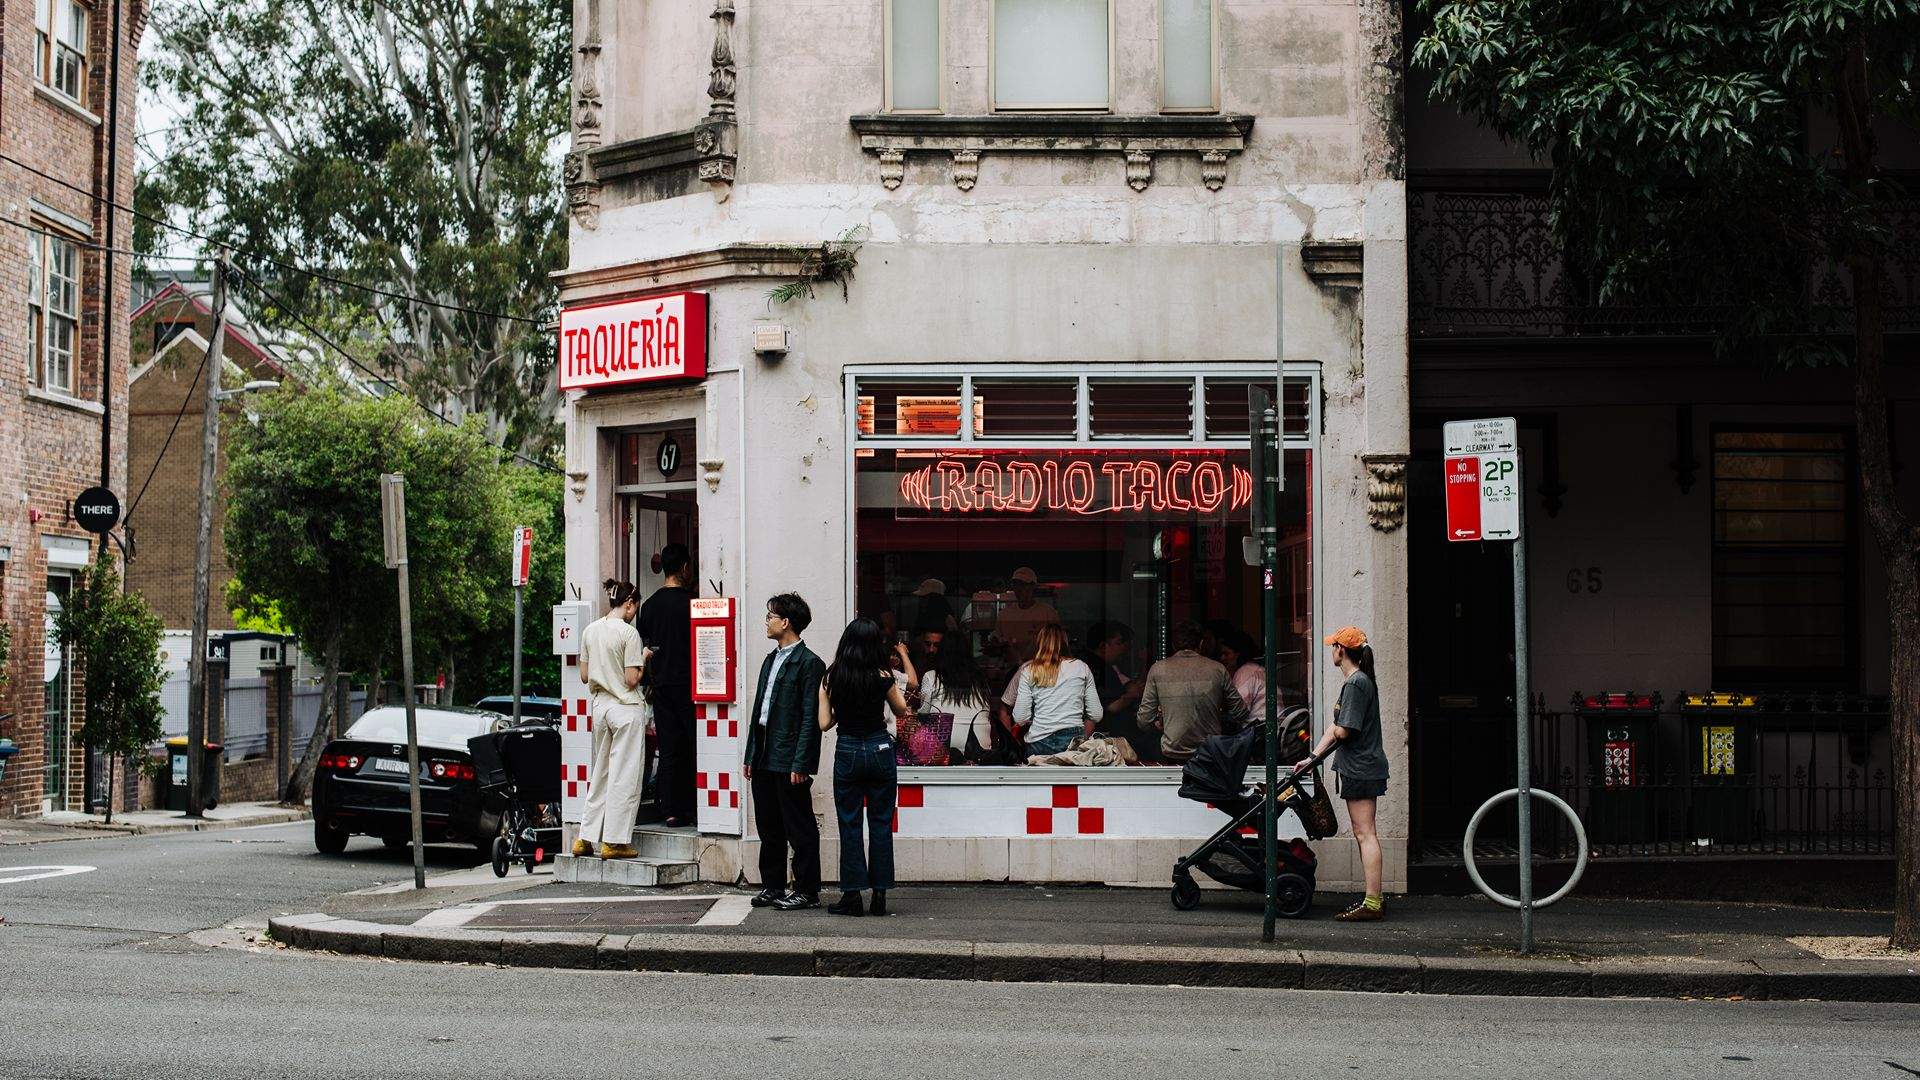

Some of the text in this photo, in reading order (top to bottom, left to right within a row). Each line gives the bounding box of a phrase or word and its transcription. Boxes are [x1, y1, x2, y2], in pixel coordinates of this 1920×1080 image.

[564, 303, 681, 378] TAQUERÍA
[1466, 444, 1494, 452] CLEARWAY
[661, 444, 677, 470] 67
[1457, 463, 1467, 472] NO
[1485, 460, 1514, 482] 2P
[937, 460, 1224, 513] RADIO TACO
[1449, 474, 1476, 484] STOPPING
[81, 505, 113, 515] THERE
[1567, 567, 1603, 594] 65
[560, 628, 571, 640] 67
